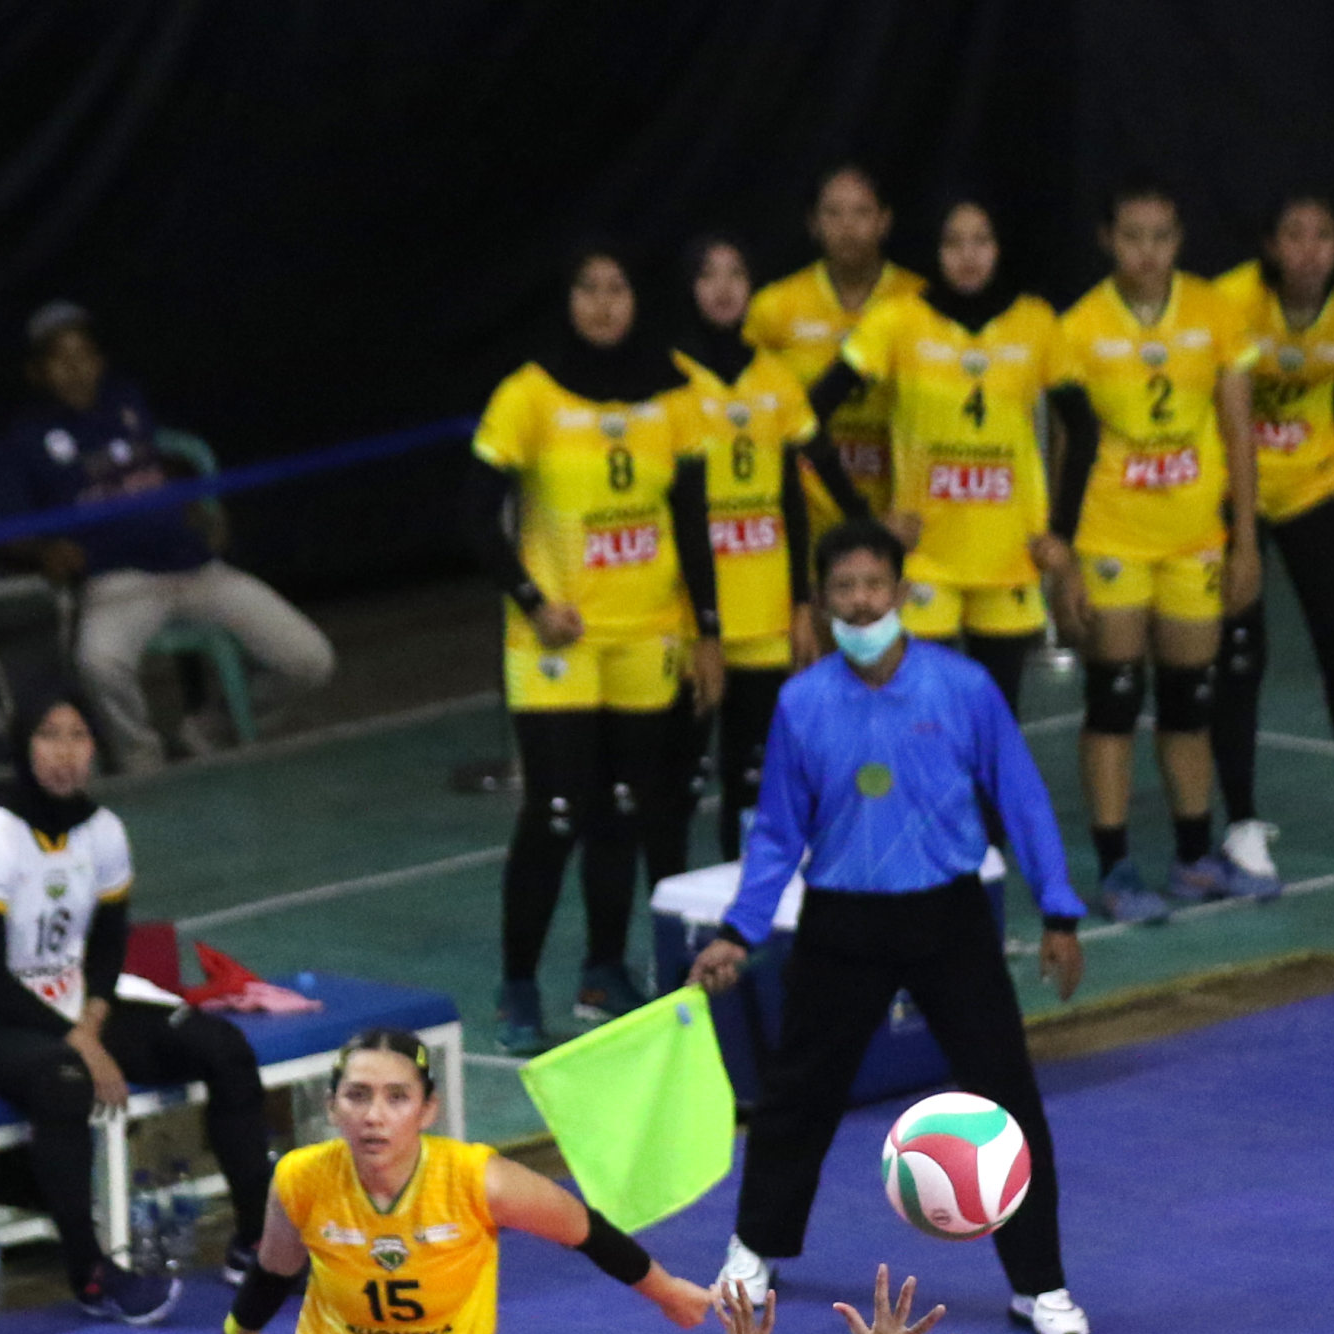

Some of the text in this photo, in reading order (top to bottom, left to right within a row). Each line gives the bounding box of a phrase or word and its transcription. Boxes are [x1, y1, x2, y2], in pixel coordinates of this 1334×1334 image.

[963, 386, 986, 428] 4
[1147, 374, 1174, 421] 2
[608, 446, 634, 492] 8
[732, 434, 756, 481] 6
[930, 466, 1011, 502] PLUS
[586, 526, 658, 566] PLUS
[363, 1279, 425, 1322] 15
